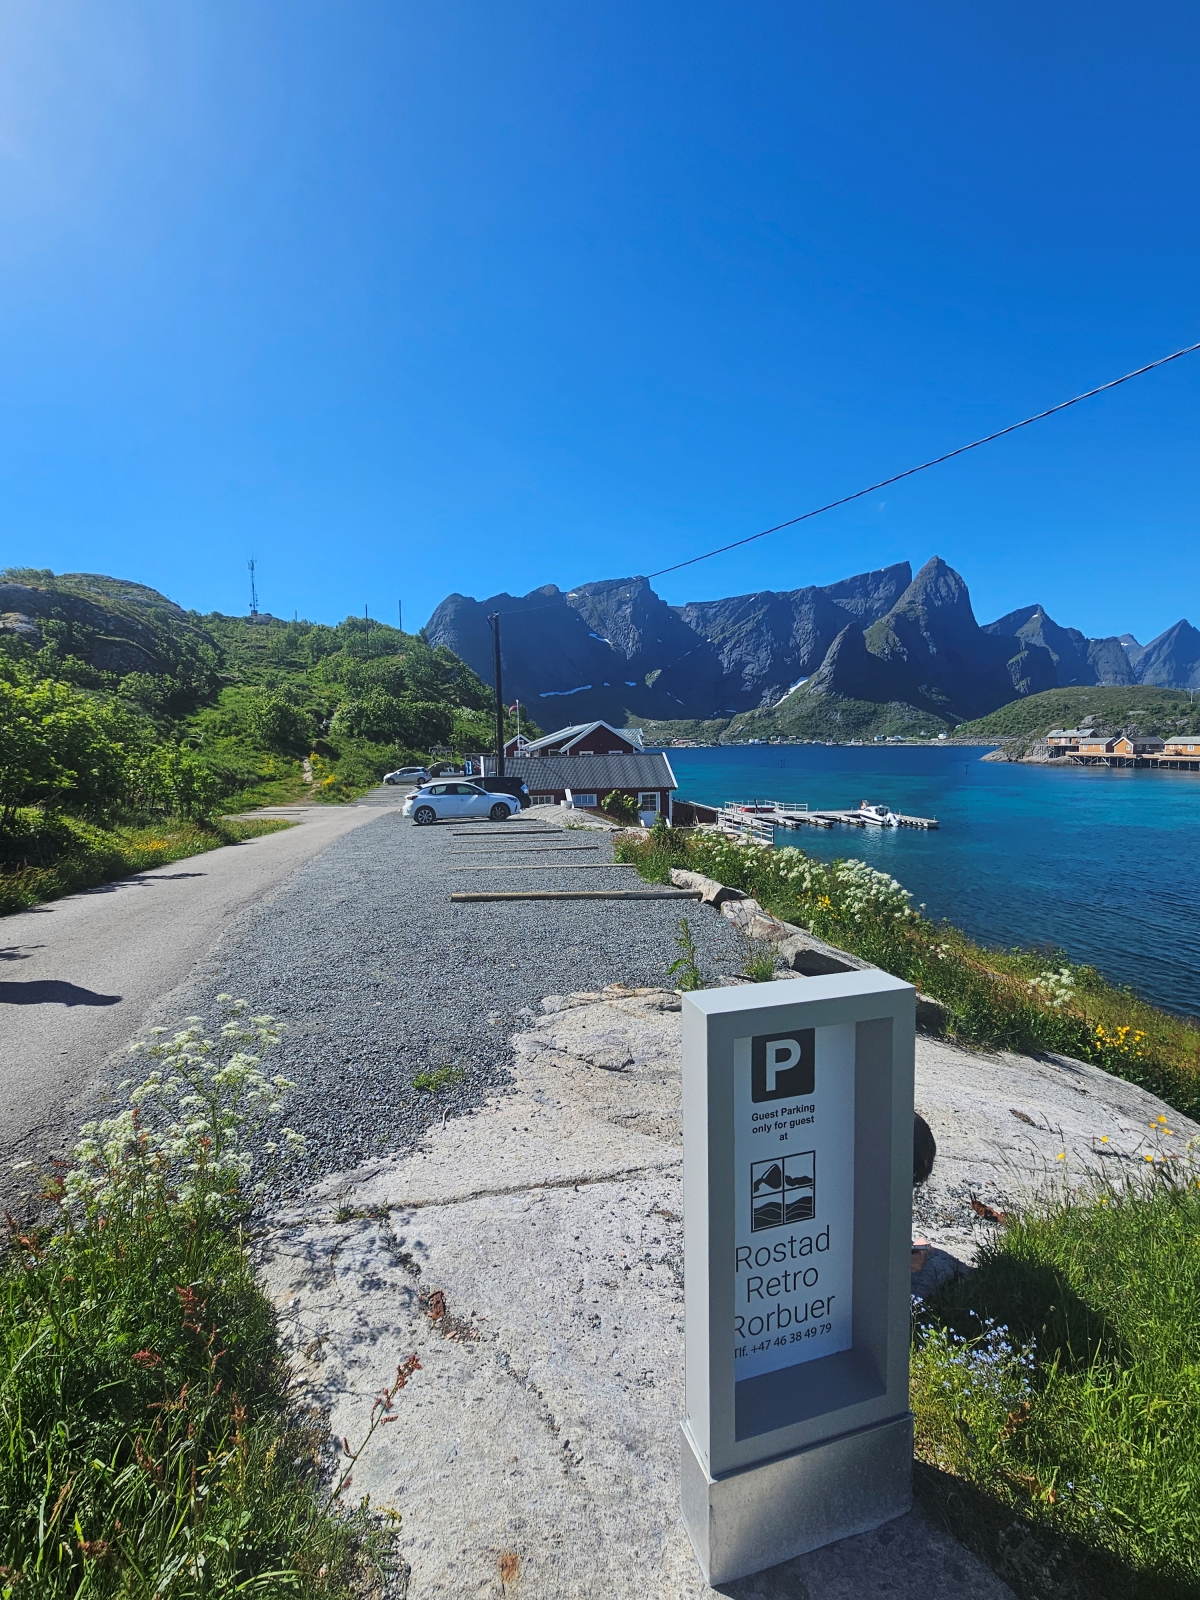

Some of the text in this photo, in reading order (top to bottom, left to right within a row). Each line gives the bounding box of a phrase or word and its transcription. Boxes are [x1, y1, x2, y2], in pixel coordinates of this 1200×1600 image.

[765, 1038, 801, 1092] P
[751, 1104, 815, 1122] Guest Parking
[752, 1116, 815, 1134] only for guest
[779, 1132, 788, 1141] at
[735, 1224, 830, 1273] Rostad
[747, 1267, 819, 1303] Retro
[751, 1339, 771, 1354] +47
[773, 1335, 787, 1347] 46
[789, 1331, 802, 1344] 38
[804, 1327, 817, 1339] 49
[819, 1322, 832, 1335] 79
